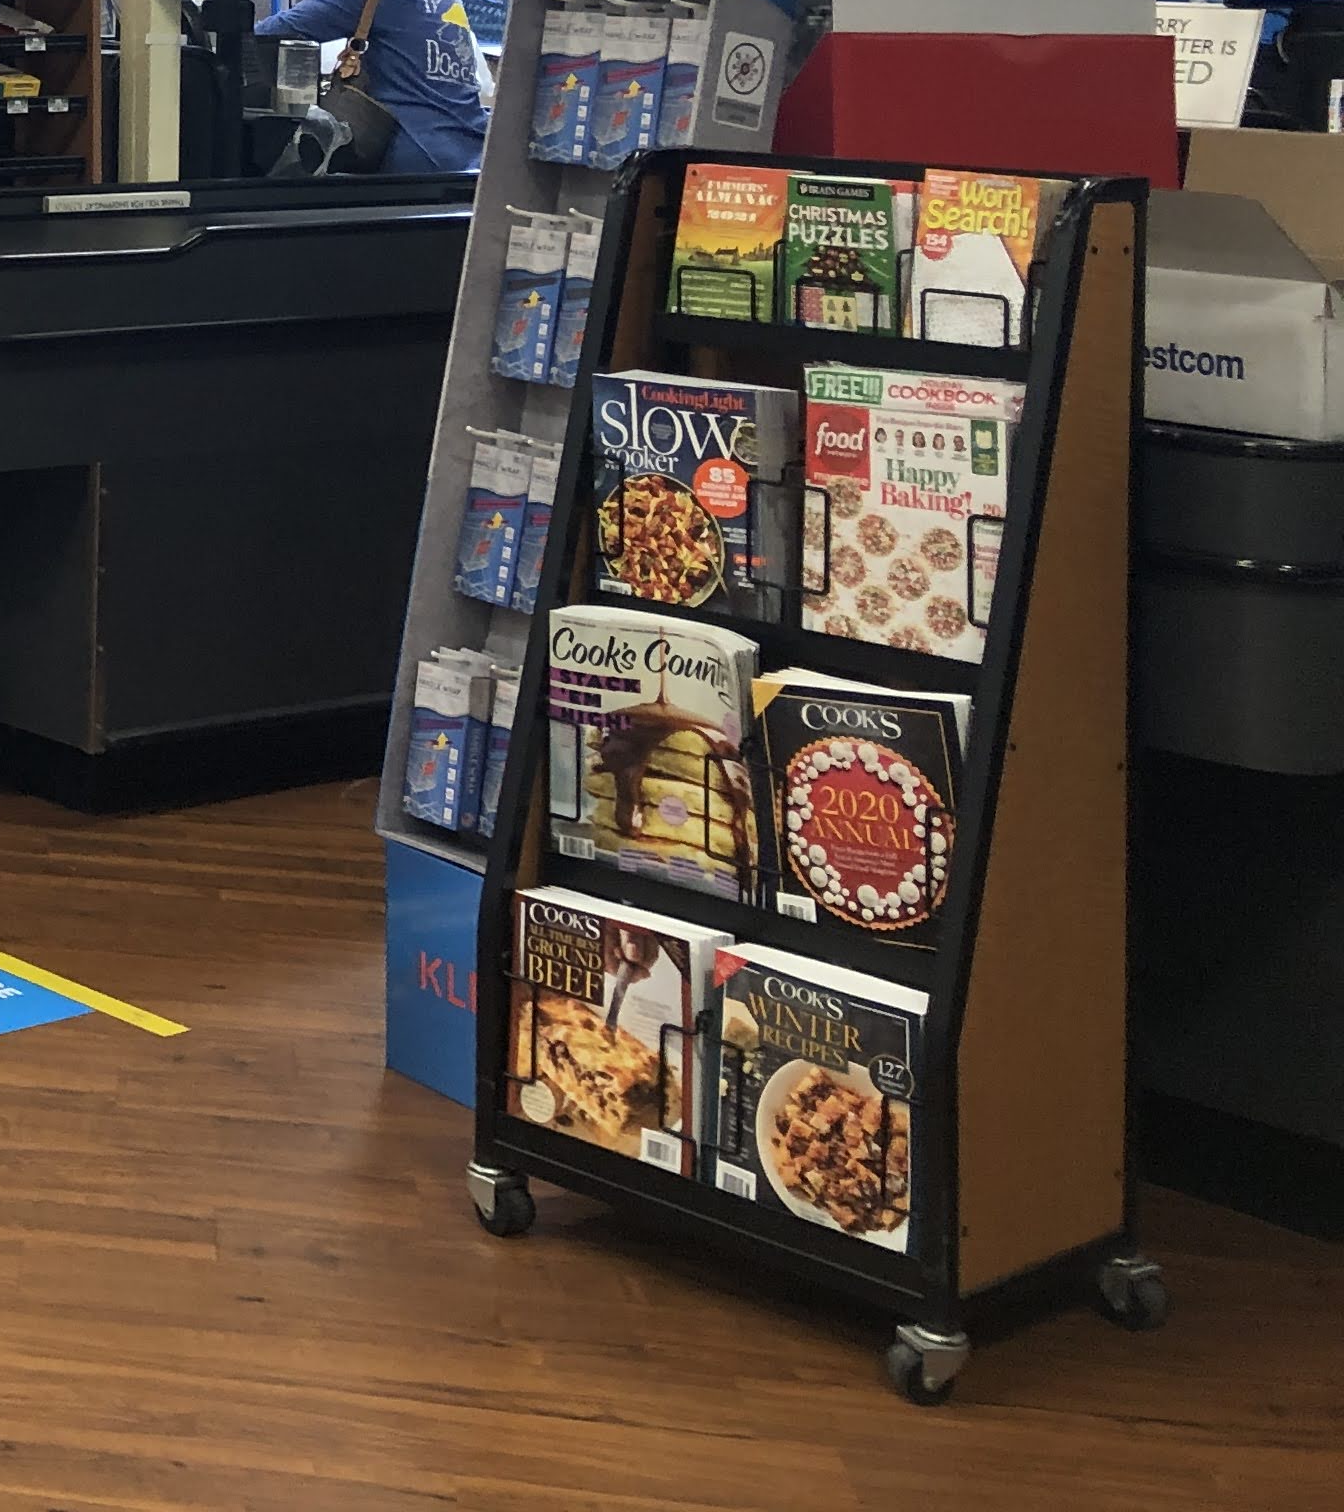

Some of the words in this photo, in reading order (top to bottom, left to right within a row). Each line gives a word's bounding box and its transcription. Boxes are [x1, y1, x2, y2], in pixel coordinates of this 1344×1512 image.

[1155, 18, 1192, 34] RRY
[1220, 39, 1238, 56] IS
[694, 189, 779, 207] ALMANAC
[809, 185, 837, 196] BRAIN
[837, 187, 870, 198] GAMES
[959, 180, 1023, 211] Word
[705, 208, 758, 224] 2021
[787, 202, 888, 227] CHRISTMAS
[924, 199, 1032, 240] Search!
[787, 221, 890, 251] PUZZLES
[1142, 342, 1245, 380] estcom
[812, 373, 882, 399] FREE!!!
[887, 384, 997, 406] COOKBOOK
[814, 420, 866, 456] food
[602, 444, 680, 475] cooker
[708, 466, 737, 484] 85
[885, 457, 962, 495] Happy
[880, 481, 973, 521] Baking!
[552, 625, 637, 673] Cook's
[561, 669, 640, 693] STACK
[801, 702, 902, 739] COOK'S
[820, 785, 900, 824] 2020
[812, 815, 918, 851] ANNUAL
[528, 901, 602, 940] COOK'S
[526, 935, 603, 971] GROUND
[526, 953, 604, 1002] BEEF
[763, 975, 845, 1021] COOK'S
[746, 990, 863, 1053] WINTER
[761, 1024, 847, 1068] RECIPES
[876, 1058, 905, 1082] 127
